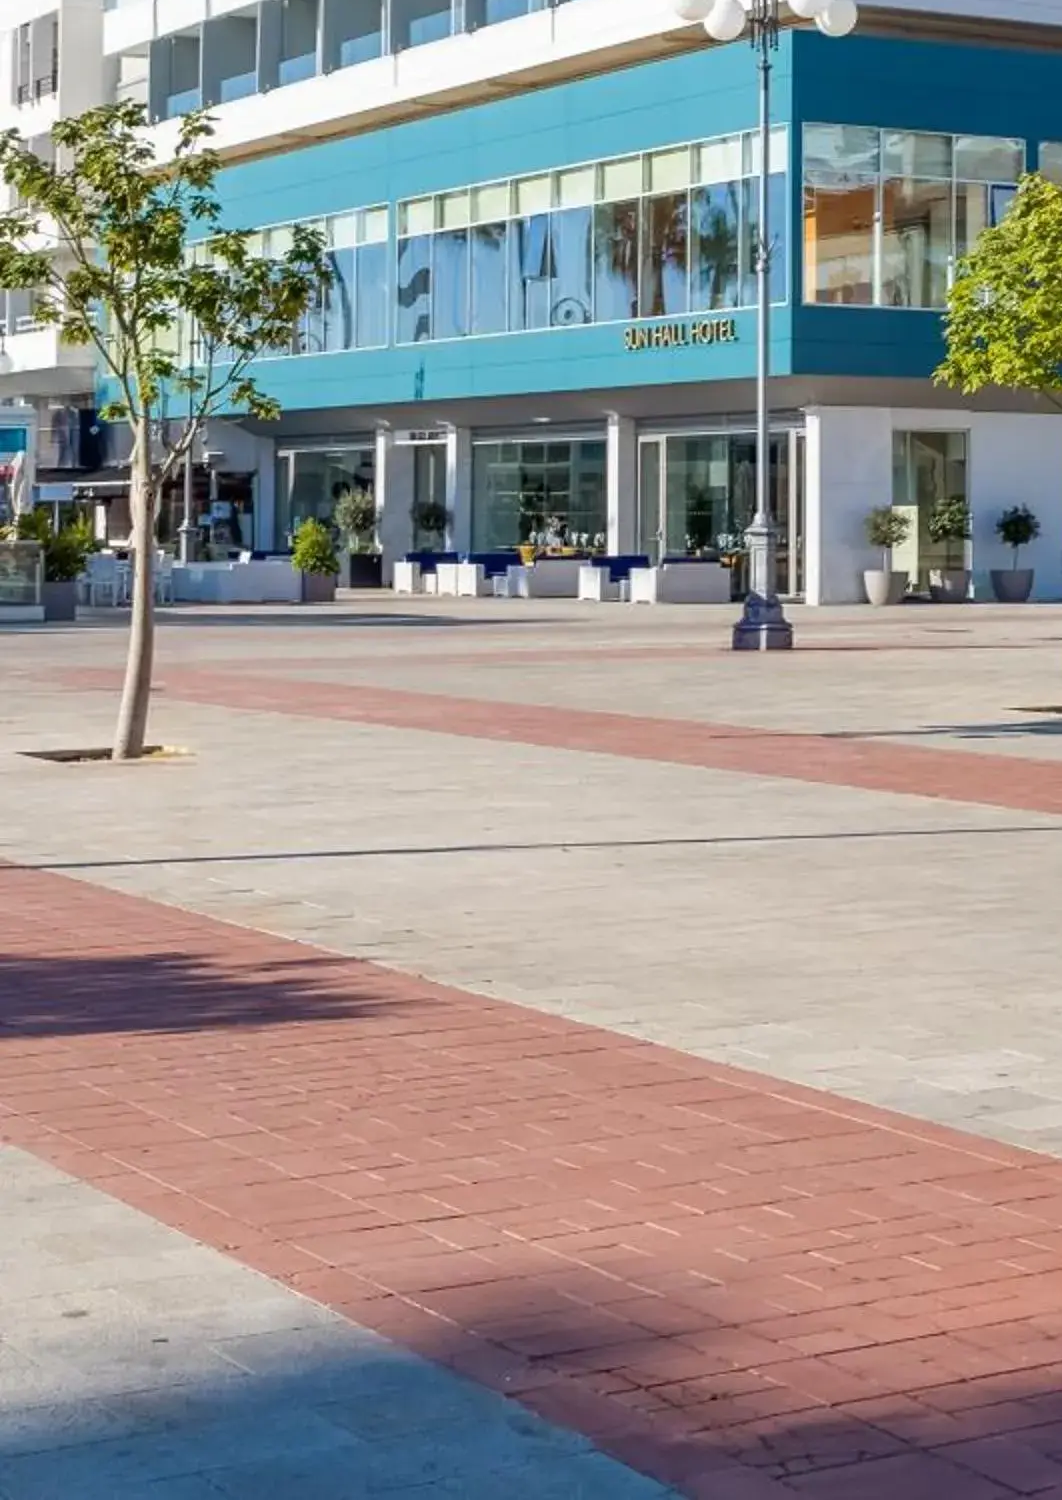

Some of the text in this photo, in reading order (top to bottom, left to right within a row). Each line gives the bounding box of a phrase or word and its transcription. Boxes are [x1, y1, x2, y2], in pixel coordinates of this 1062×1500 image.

[624, 318, 739, 351] SUN HALL HOTEL
